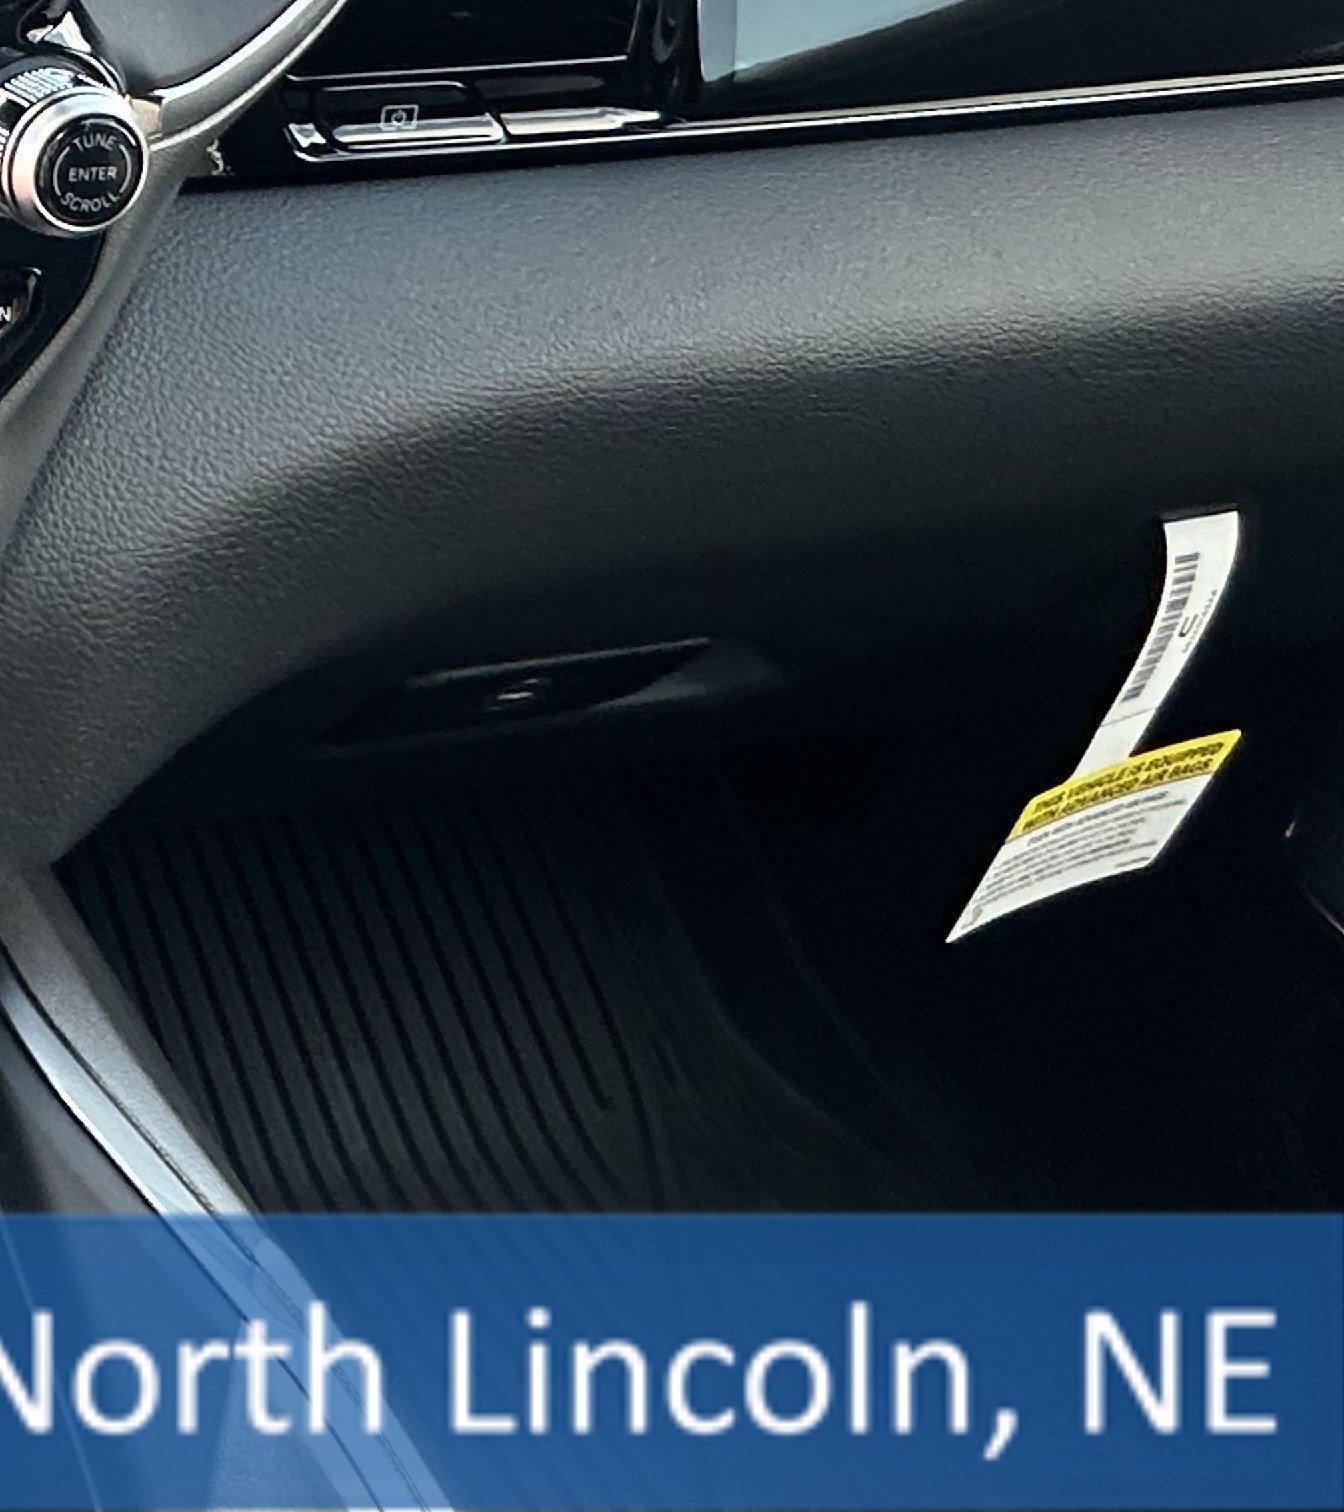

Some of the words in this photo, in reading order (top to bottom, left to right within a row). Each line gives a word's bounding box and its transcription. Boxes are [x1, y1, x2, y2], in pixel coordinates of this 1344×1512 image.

[72, 134, 118, 153] TUNE
[68, 166, 118, 183] ENTER
[61, 191, 122, 214] SCROLL
